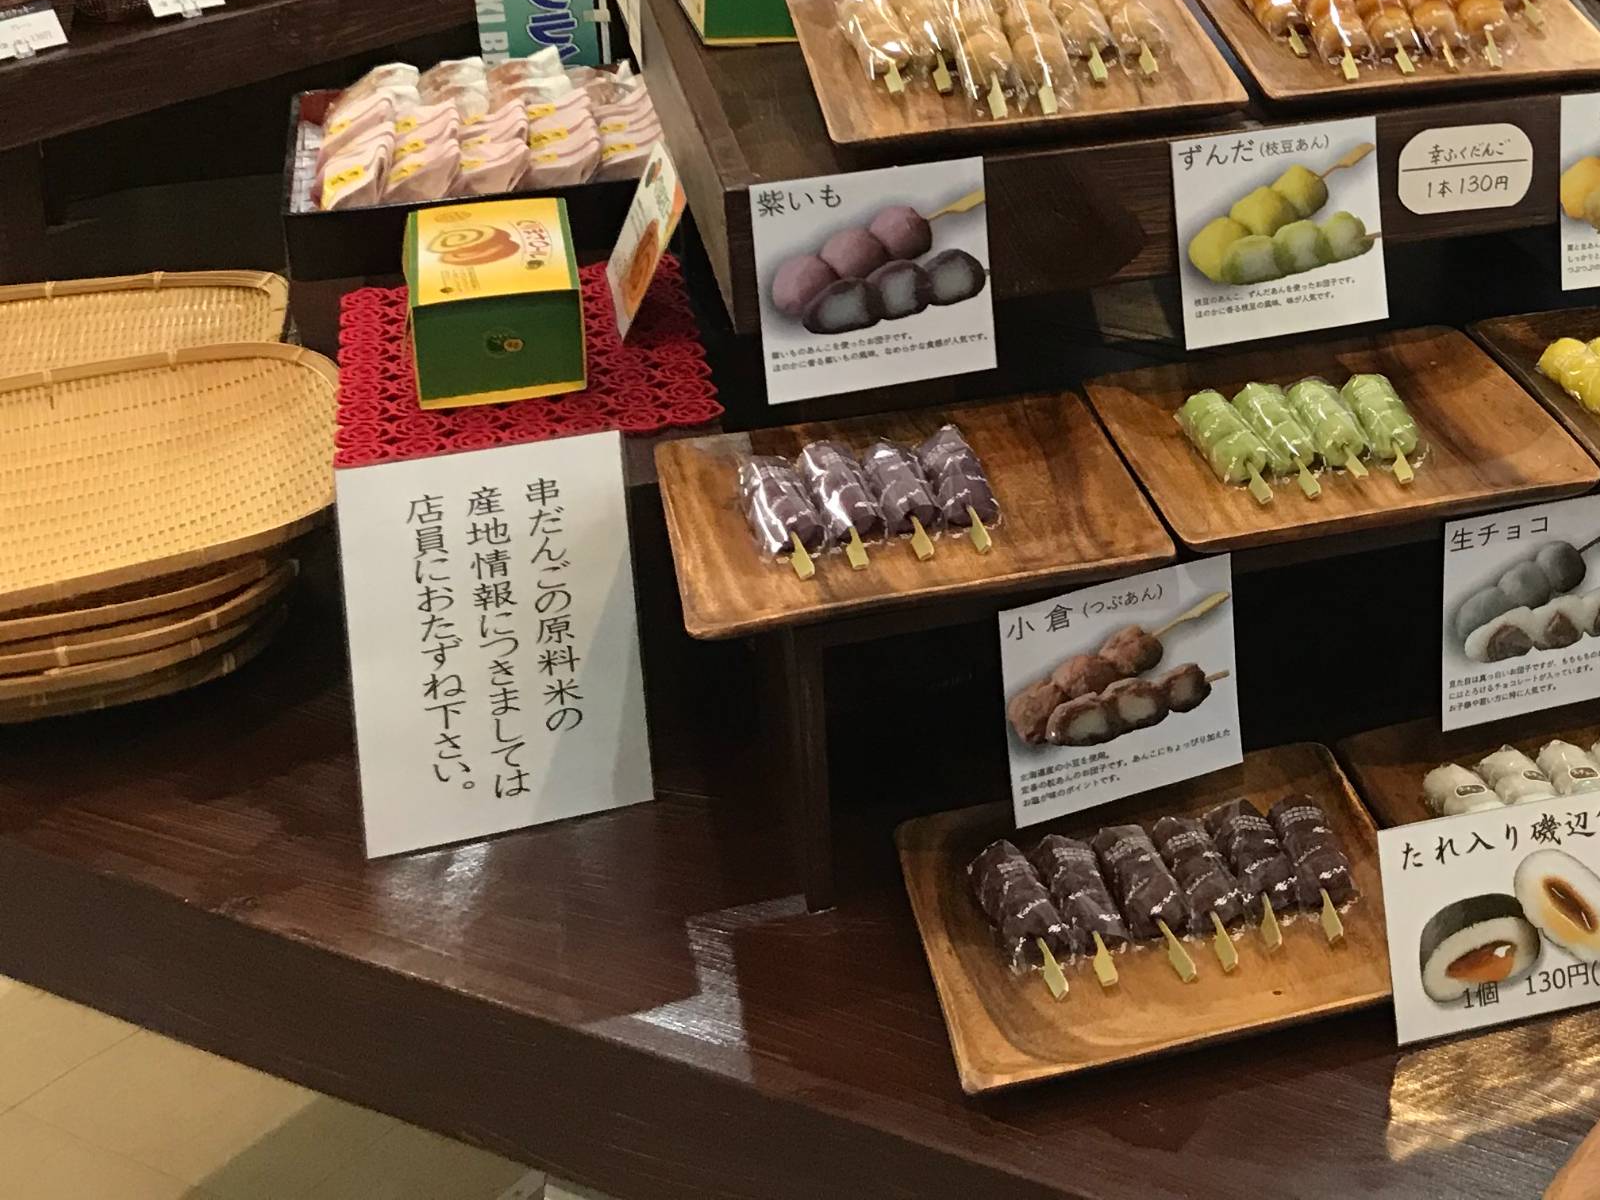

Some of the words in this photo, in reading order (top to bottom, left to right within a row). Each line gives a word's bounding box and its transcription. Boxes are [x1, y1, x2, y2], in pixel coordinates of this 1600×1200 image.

[1178, 134, 1330, 171] ずんだ(枝豆あん)
[1428, 139, 1511, 166] 幸ふくだんご
[757, 184, 843, 217] 紫いも
[1459, 174, 1509, 195] 130円
[1450, 516, 1549, 552] 生チョコ
[525, 477, 584, 733] 串だんごの原料米の
[1007, 583, 1164, 641] 小倉(つぶあん)
[406, 494, 476, 791] 店員におたずね下さい。
[465, 486, 531, 799] 産地情報につきましては
[1462, 981, 1500, 1009] 1個
